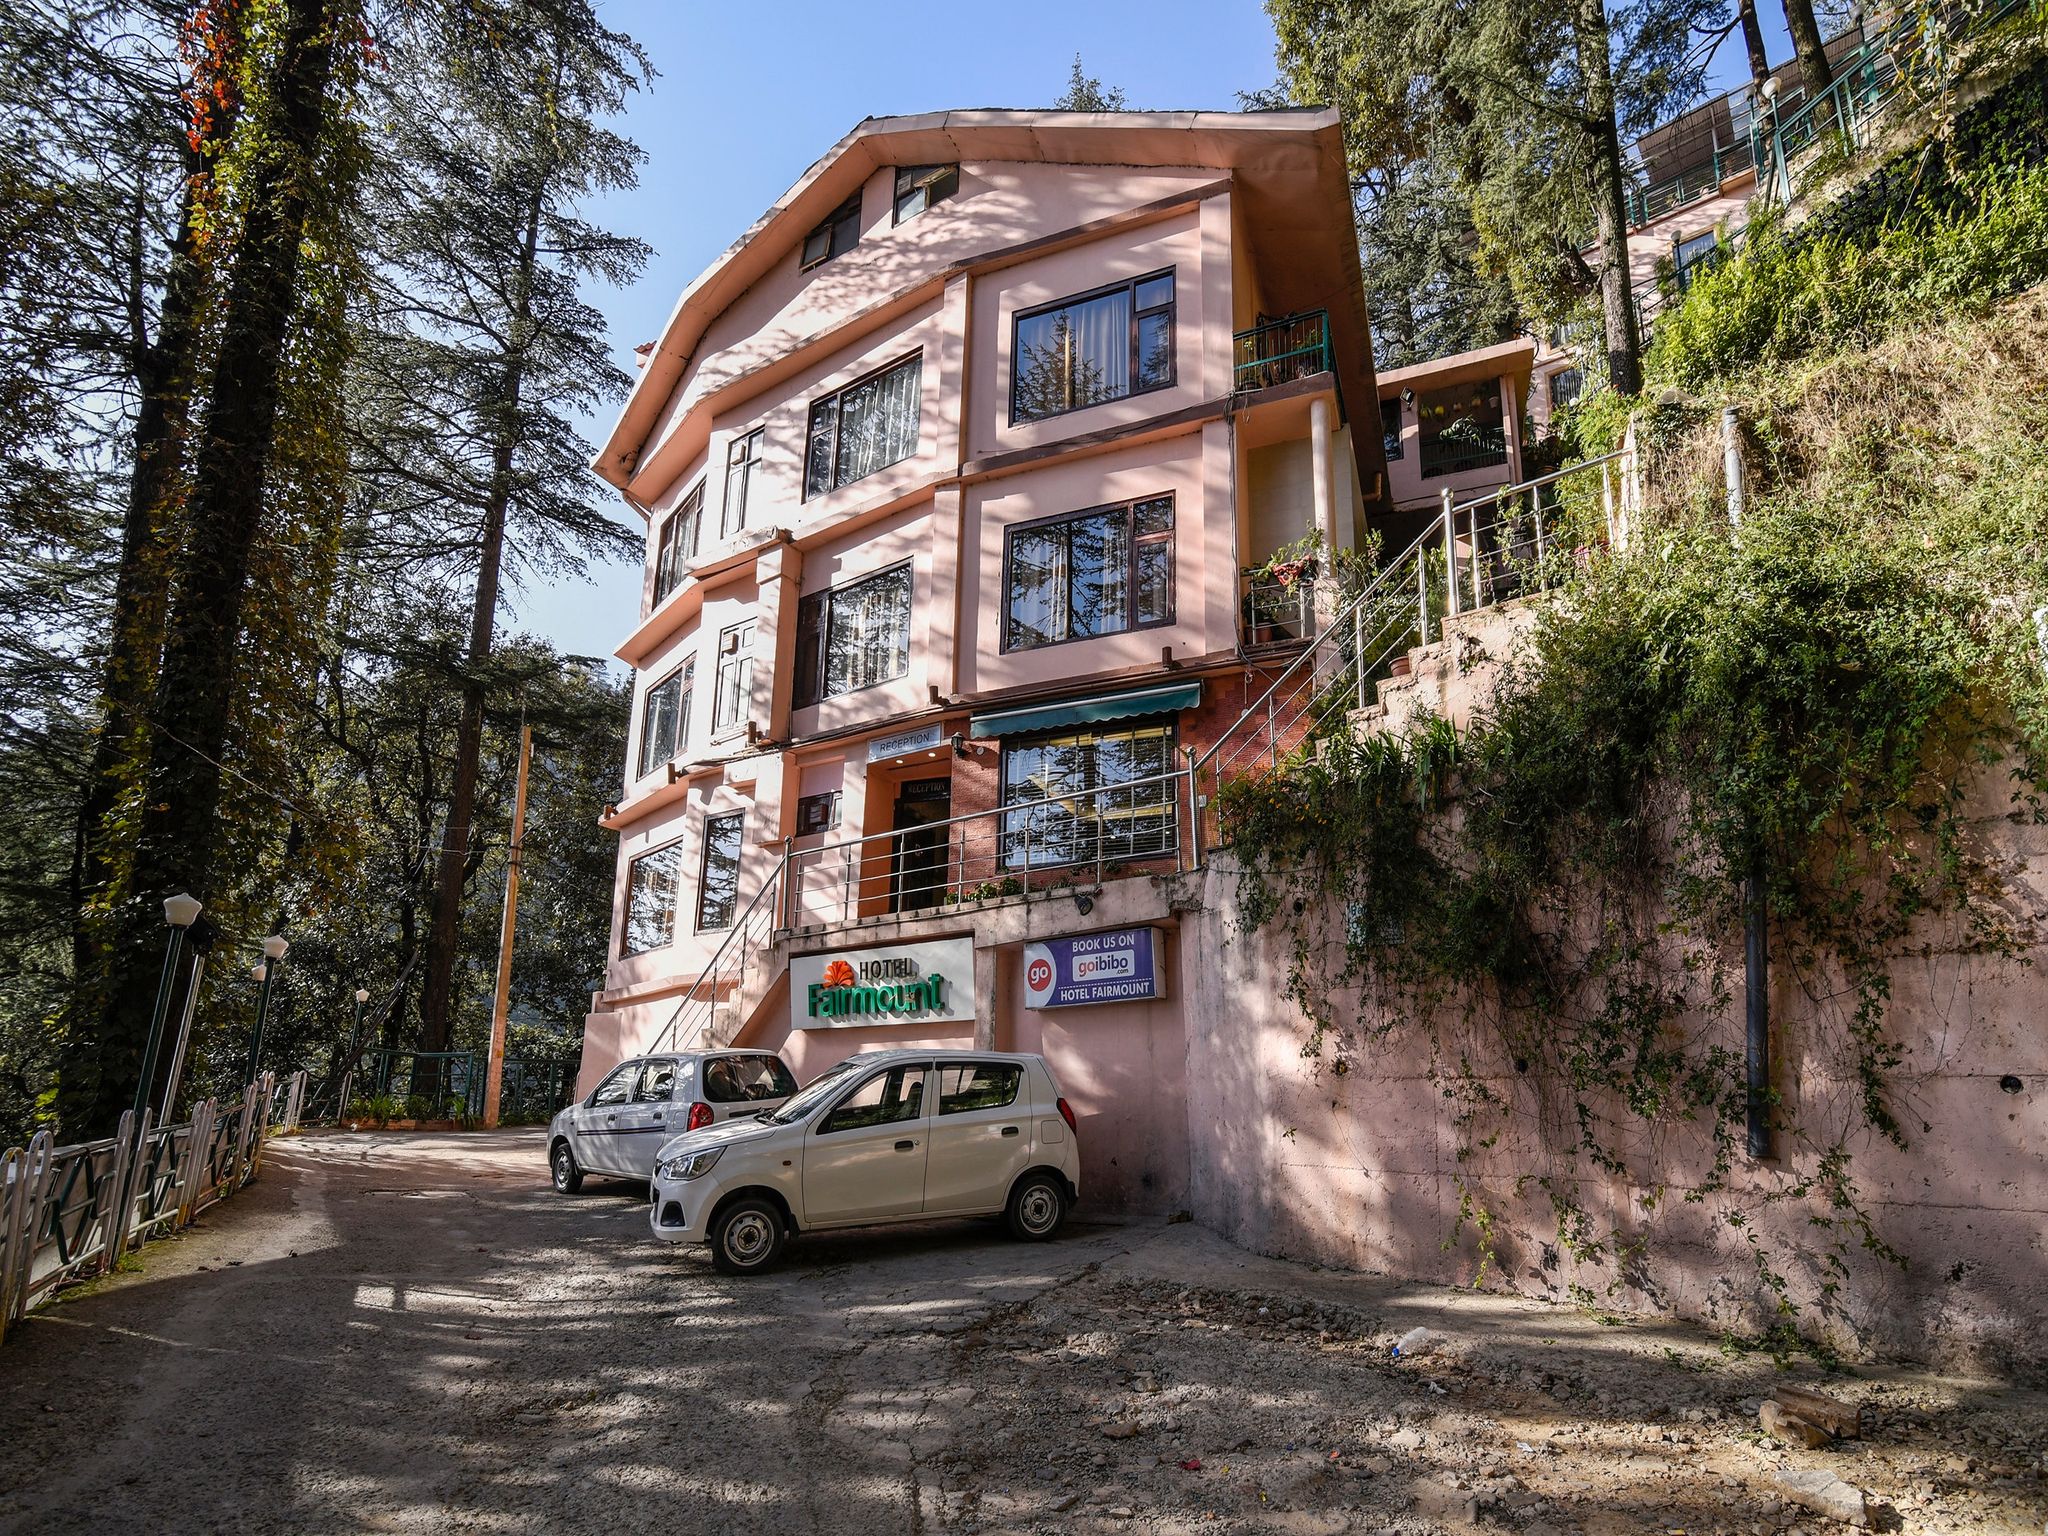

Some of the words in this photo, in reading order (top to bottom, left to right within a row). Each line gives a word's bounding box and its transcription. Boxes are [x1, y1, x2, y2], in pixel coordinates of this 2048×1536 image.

[880, 733, 930, 752] RECEPTION
[1072, 939, 1100, 952] BOOK
[1103, 936, 1116, 949] US
[1118, 934, 1135, 946] ON
[860, 958, 914, 980] HOTEL
[1031, 966, 1049, 984] go
[1079, 955, 1128, 977] goibibo
[808, 973, 946, 1017] Fairmount
[1060, 988, 1090, 1001] HOTEL
[1092, 982, 1150, 998] FAIRMOUNT
